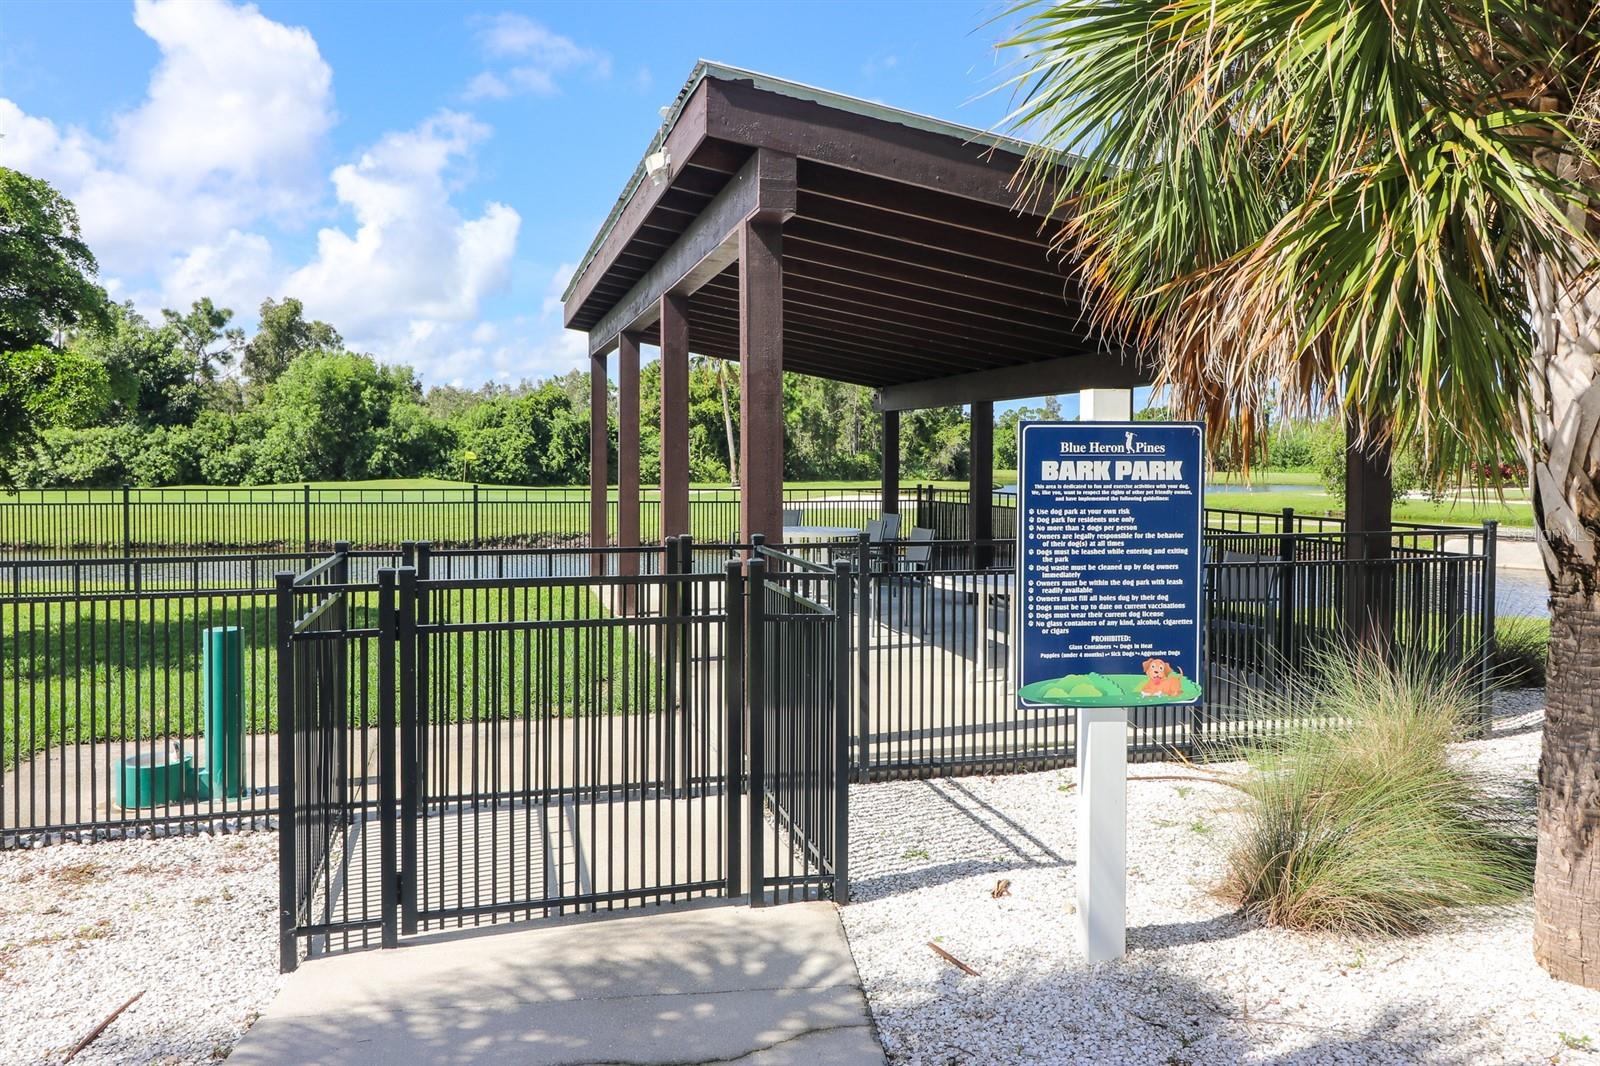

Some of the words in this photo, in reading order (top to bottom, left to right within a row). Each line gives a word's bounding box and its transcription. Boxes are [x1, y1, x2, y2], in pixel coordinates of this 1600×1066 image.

[1061, 442, 1086, 453] Blue
[1089, 442, 1124, 453] Heron
[1136, 442, 1165, 453] Pines
[1041, 461, 1111, 480] BARK
[1115, 461, 1183, 480] PARK
